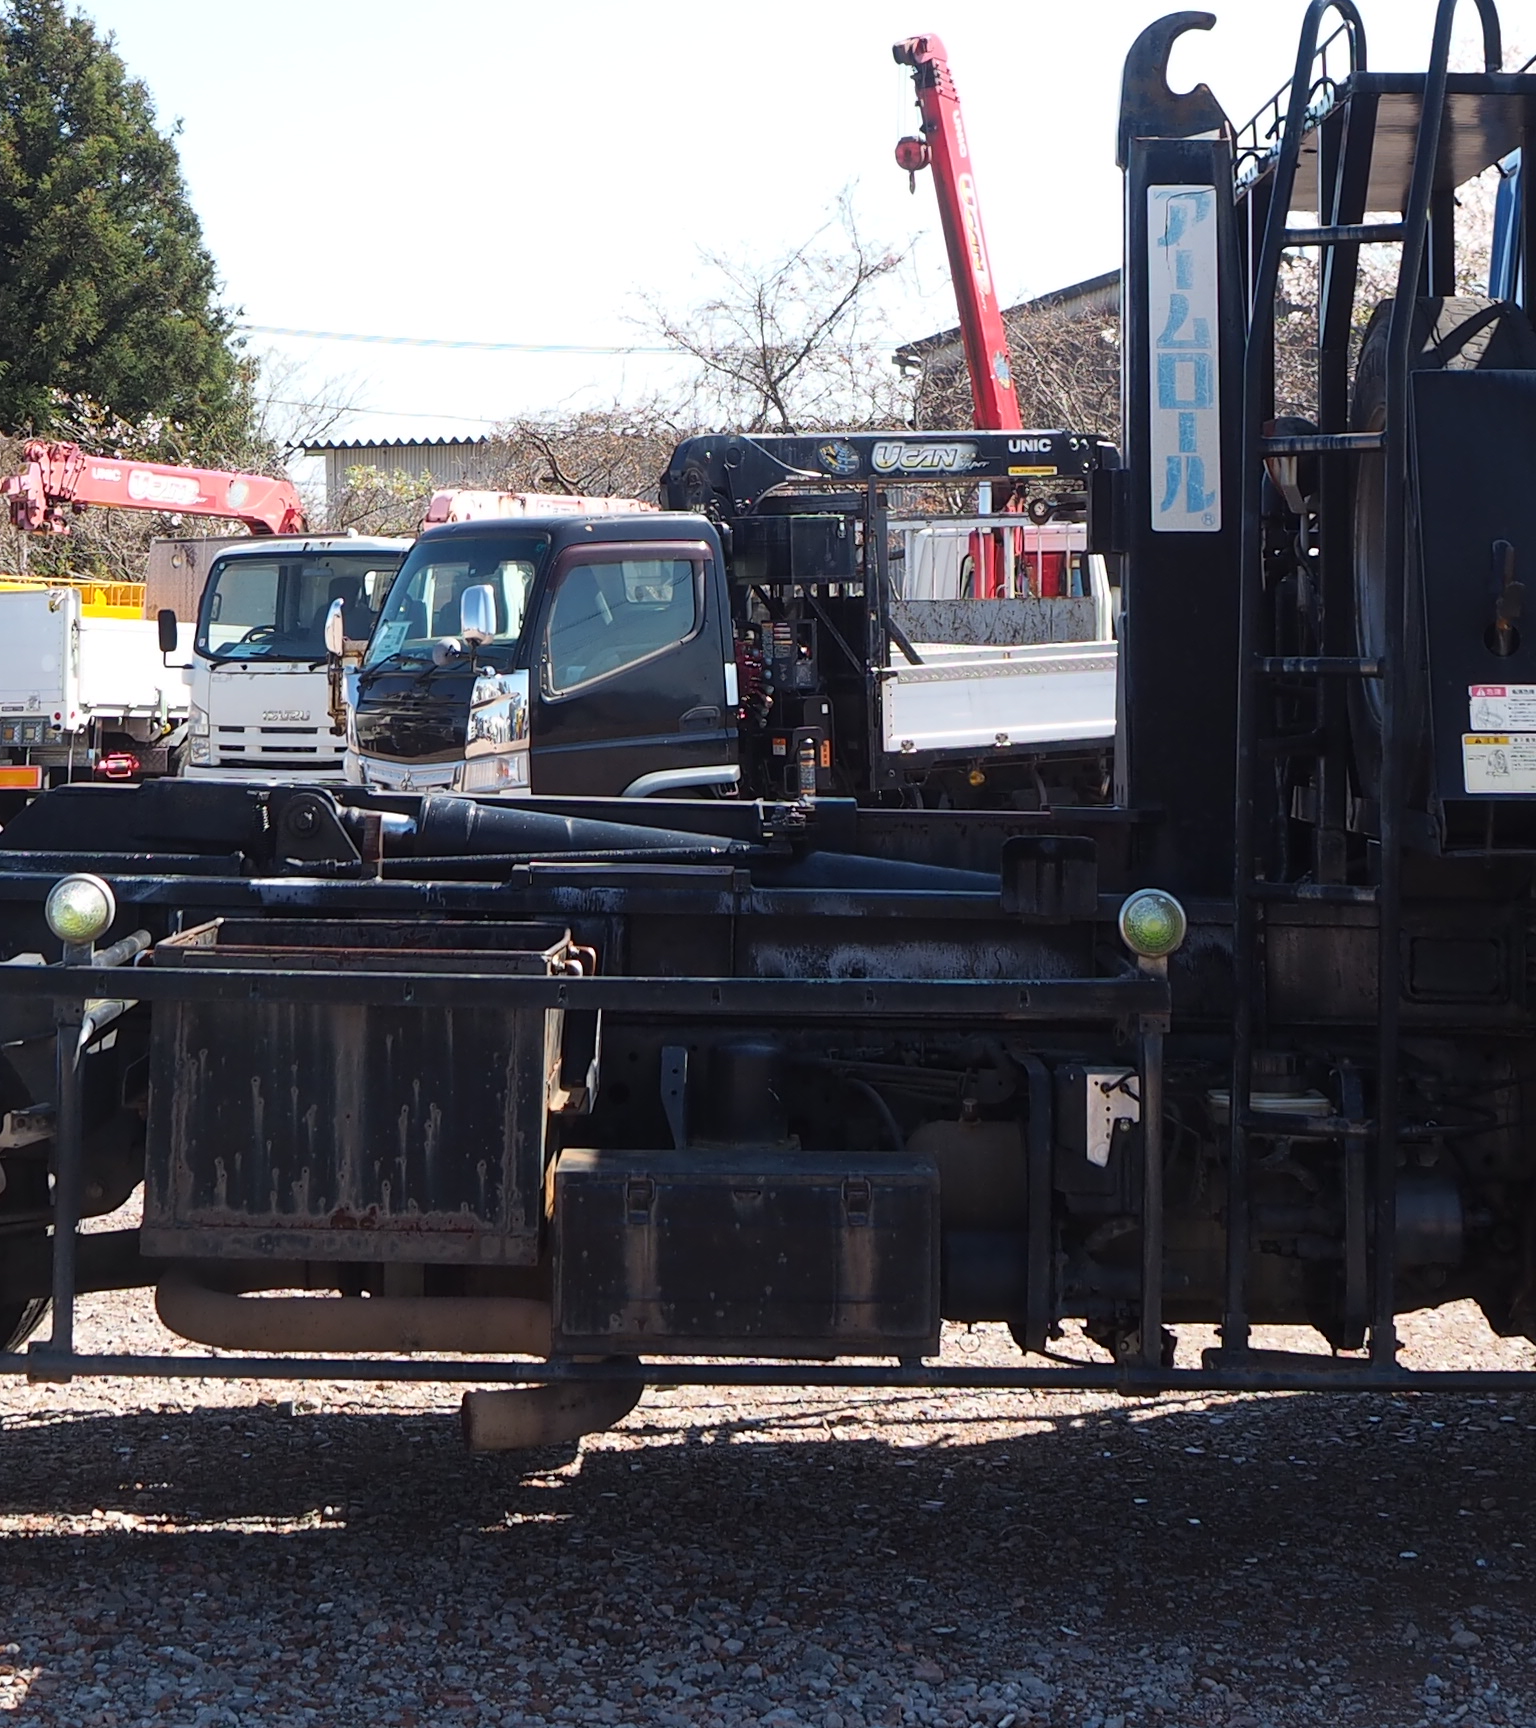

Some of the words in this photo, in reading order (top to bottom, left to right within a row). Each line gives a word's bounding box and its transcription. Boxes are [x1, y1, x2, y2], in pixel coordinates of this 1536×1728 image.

[1154, 190, 1216, 514] アームロール
[1008, 438, 1052, 453] UNIC
[263, 711, 311, 722] ISUZU
